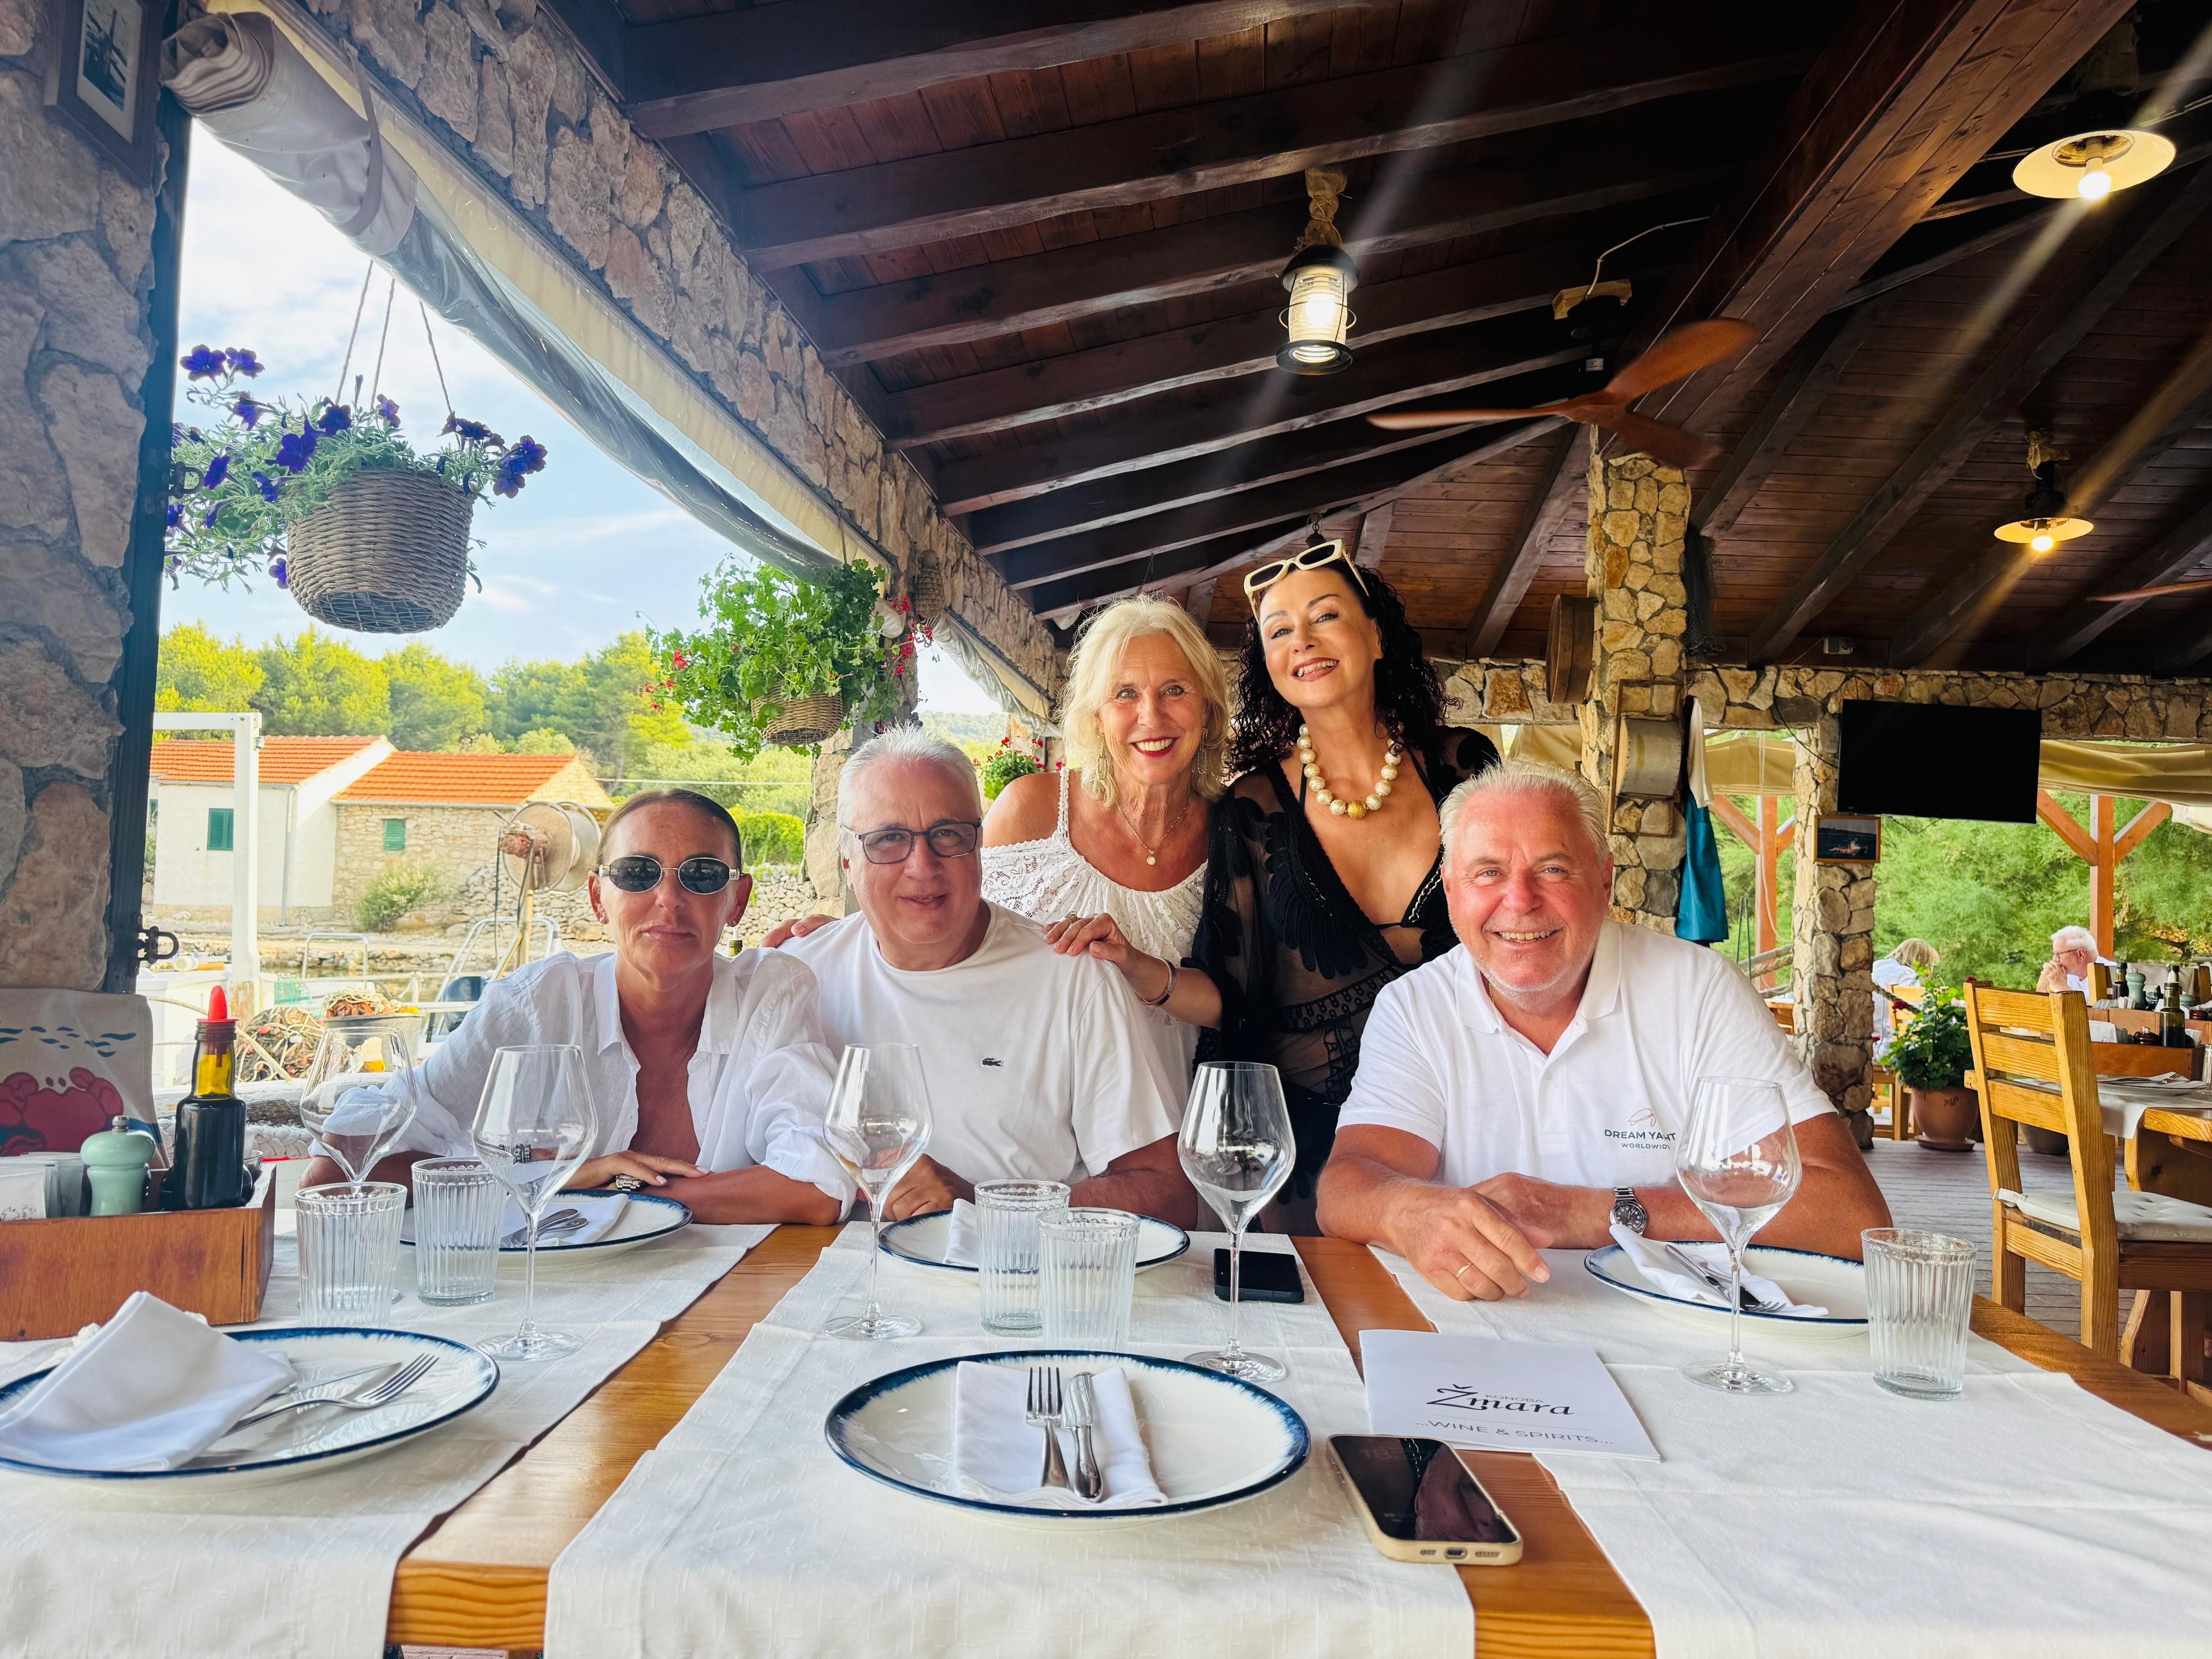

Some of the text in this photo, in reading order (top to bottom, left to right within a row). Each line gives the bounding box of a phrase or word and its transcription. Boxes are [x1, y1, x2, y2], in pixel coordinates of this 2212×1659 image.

[1605, 1129, 1646, 1139] DREAM
[1426, 1384, 1575, 1415] Žmara
[1485, 1394, 1545, 1403] KONOBA
